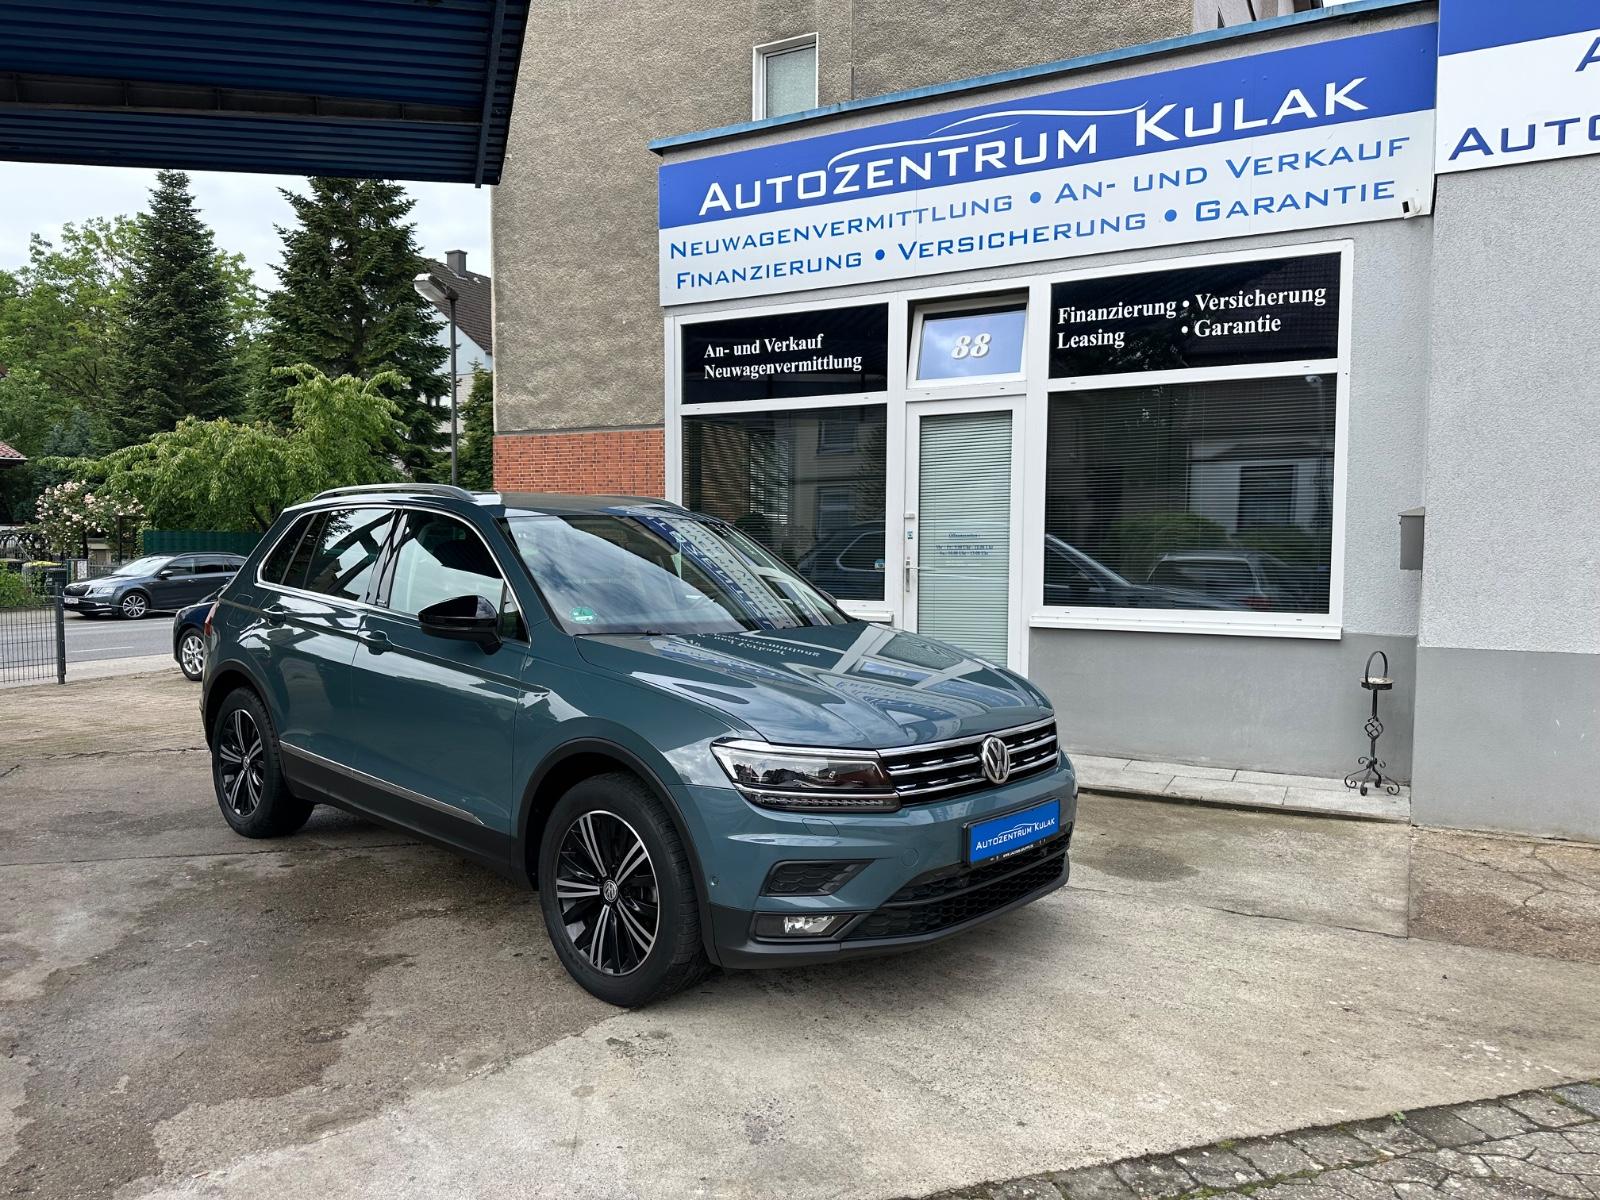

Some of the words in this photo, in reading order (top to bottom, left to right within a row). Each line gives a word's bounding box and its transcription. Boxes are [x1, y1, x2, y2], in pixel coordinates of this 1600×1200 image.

[699, 124, 1097, 215] AUTOZENTRUM
[1136, 78, 1367, 147] KULAK
[671, 196, 1012, 259] NEUWAGENVERMITTLUNG
[1055, 182, 1116, 204] AN-
[1134, 167, 1208, 193] UND
[1226, 137, 1411, 179] VERKAUF
[677, 252, 862, 289] FINANZIERUNG
[898, 214, 1146, 261] VERSICHERUNG
[1195, 181, 1395, 223] GARANTIE
[1057, 301, 1177, 325] Finanzierung
[1194, 288, 1327, 311] Versicherung
[704, 344, 730, 359] An-
[733, 340, 760, 356] und
[763, 333, 824, 353] Verkauf
[951, 333, 992, 360] 88
[1057, 328, 1125, 349] Leasing
[1194, 316, 1282, 338] Garantie
[704, 354, 863, 380] Neuwagenvermittlung
[976, 826, 1032, 850] AUTOZENTRUM
[1034, 818, 1055, 833] KULAK
